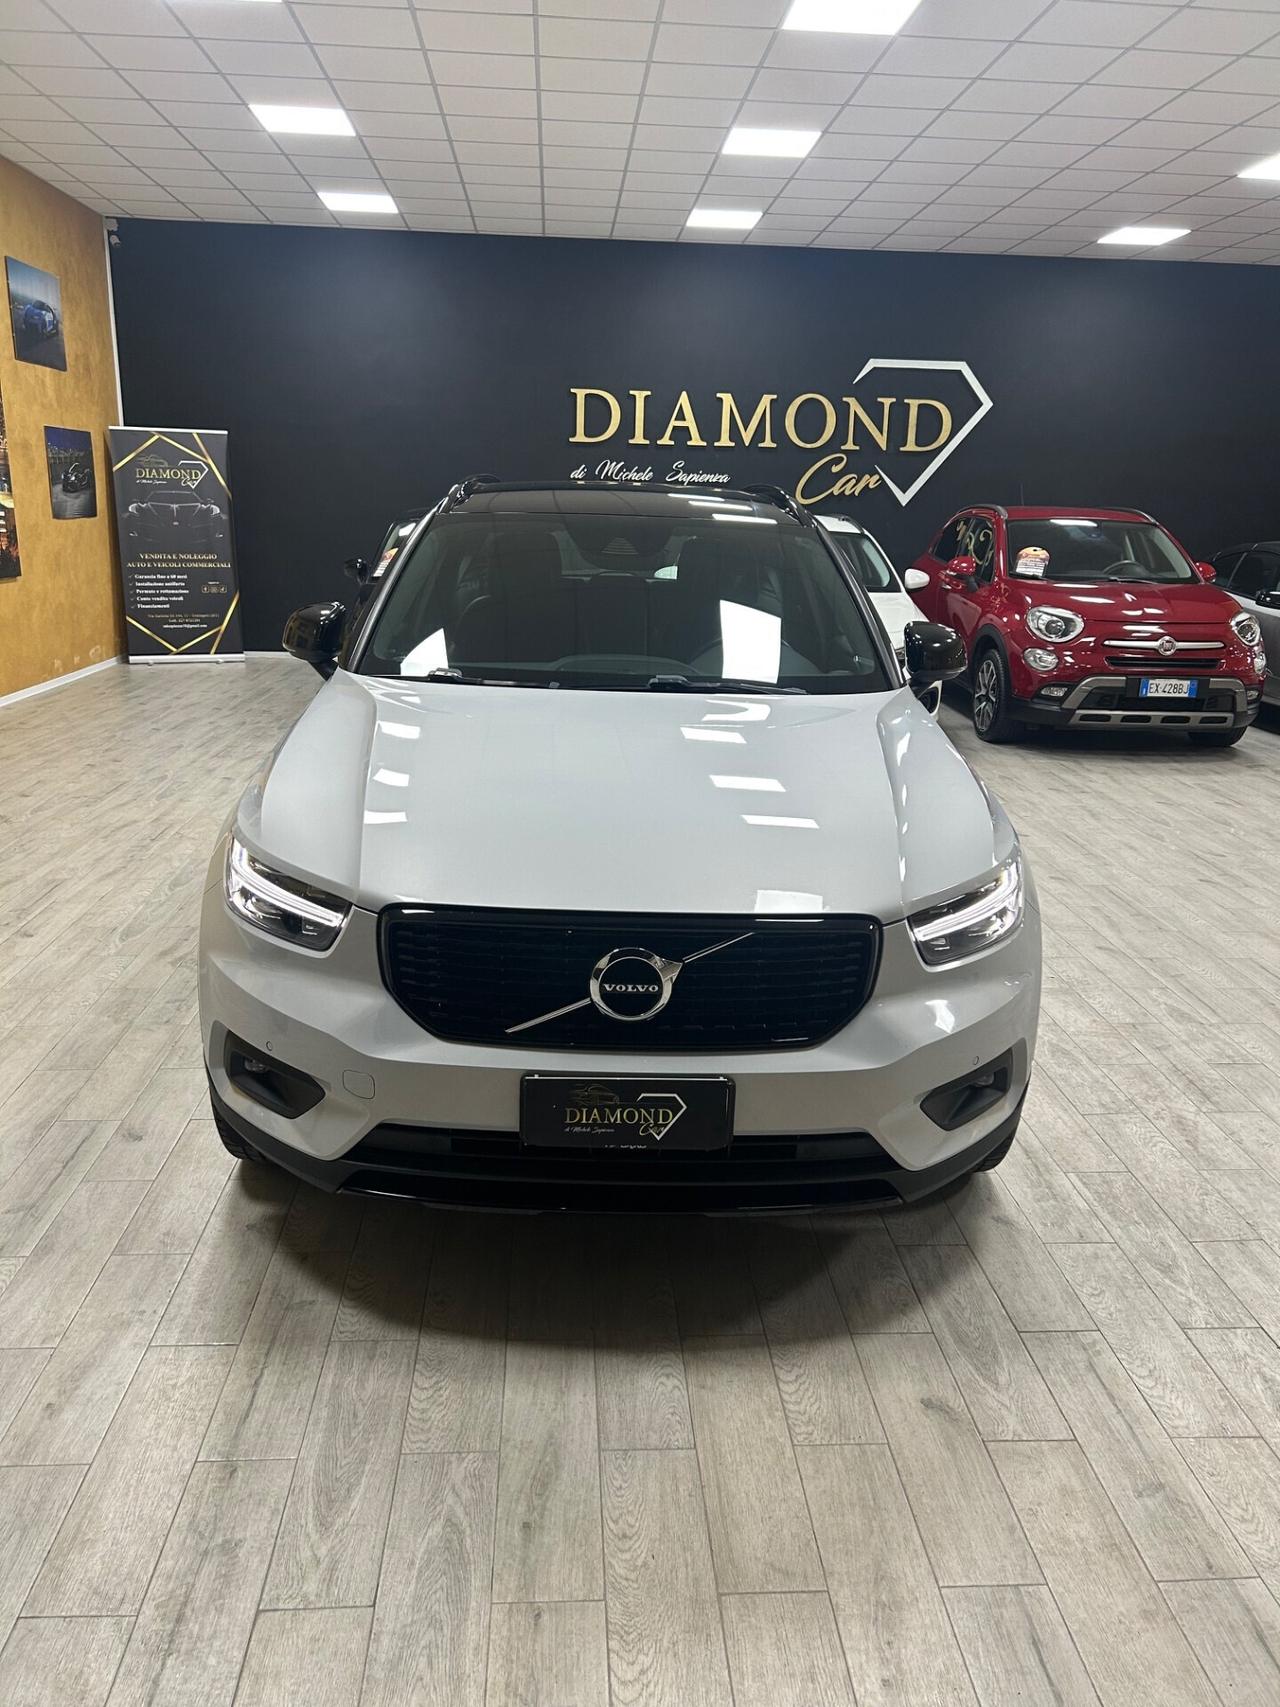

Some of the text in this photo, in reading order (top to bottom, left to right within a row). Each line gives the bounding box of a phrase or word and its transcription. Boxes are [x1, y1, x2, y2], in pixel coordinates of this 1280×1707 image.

[568, 387, 953, 453] DIAMOND
[136, 468, 201, 479] DIAMOND
[570, 459, 731, 484] di Michele Sapienza
[795, 453, 881, 506] Car
[1148, 683, 1160, 694] EX
[1162, 683, 1189, 694] 428BJ
[603, 984, 659, 992] VOLVO
[564, 1107, 673, 1124] DIAMOND
